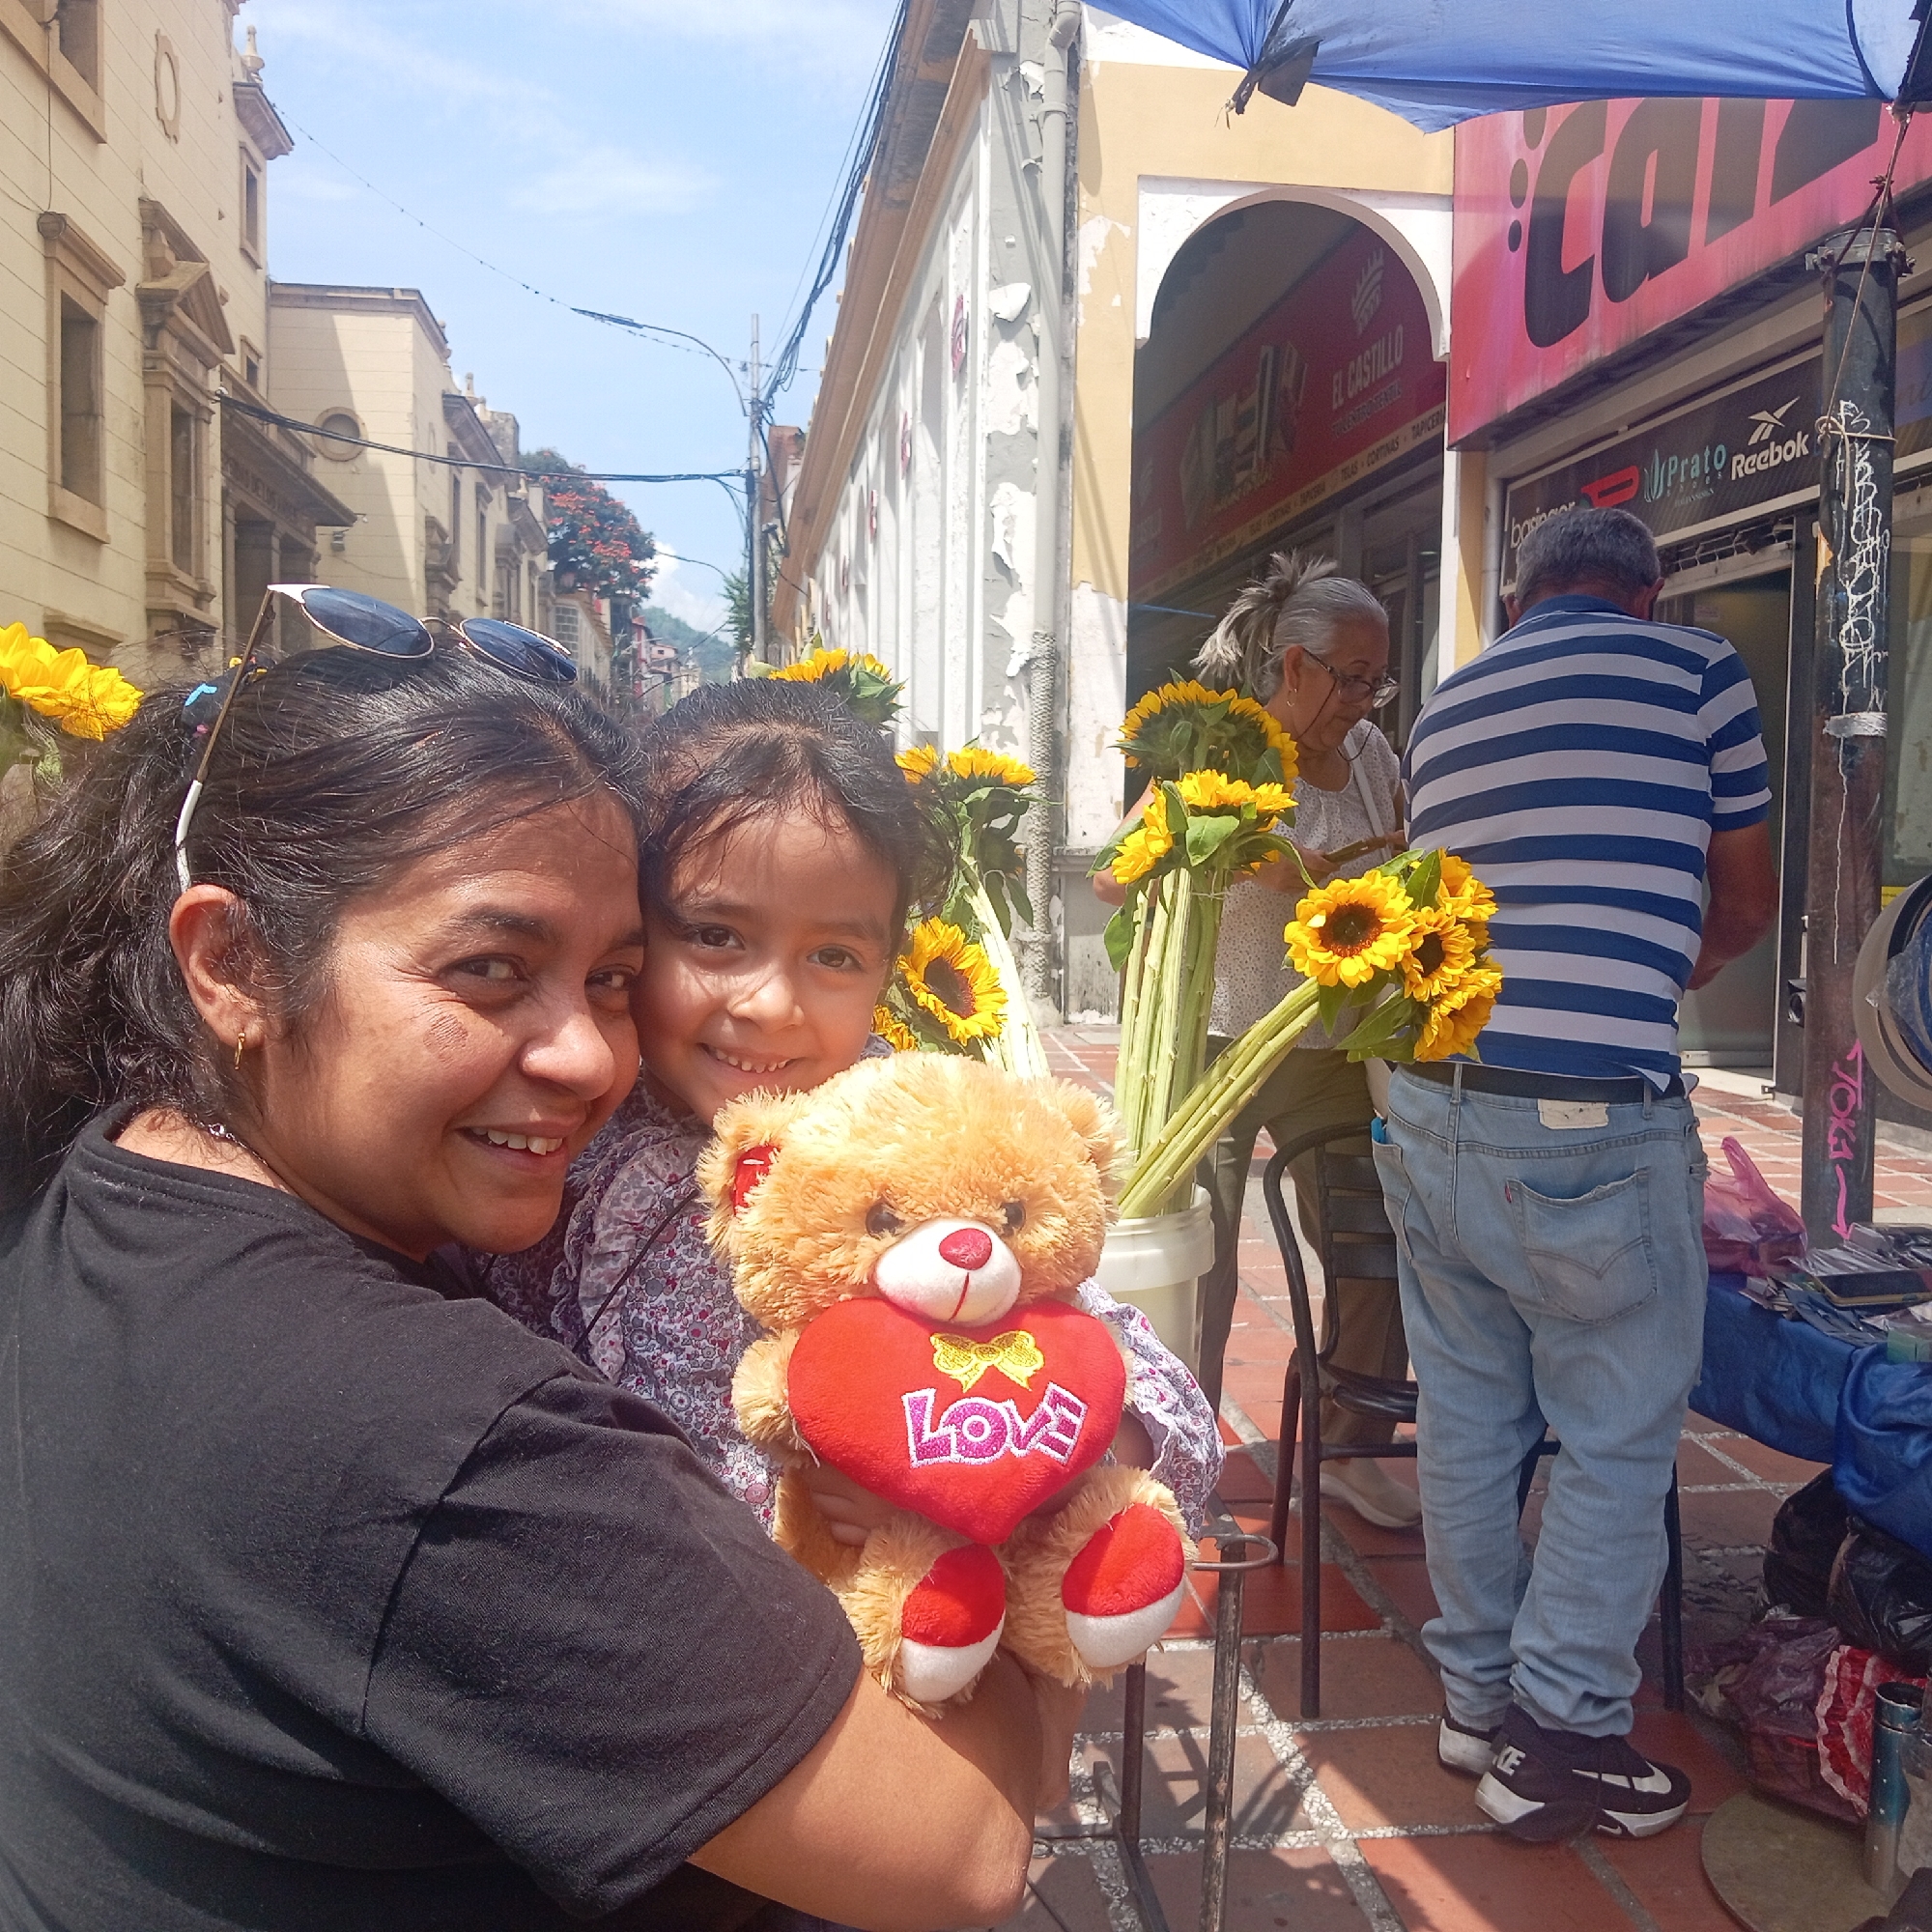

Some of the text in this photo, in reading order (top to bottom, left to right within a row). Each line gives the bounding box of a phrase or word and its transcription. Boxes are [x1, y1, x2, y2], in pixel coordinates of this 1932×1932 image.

[1332, 324, 1404, 411] EL CASTILLO
[1667, 443, 1727, 487] Prato
[1731, 431, 1809, 480] Reebok
[901, 1382, 1089, 1468] LOVE
